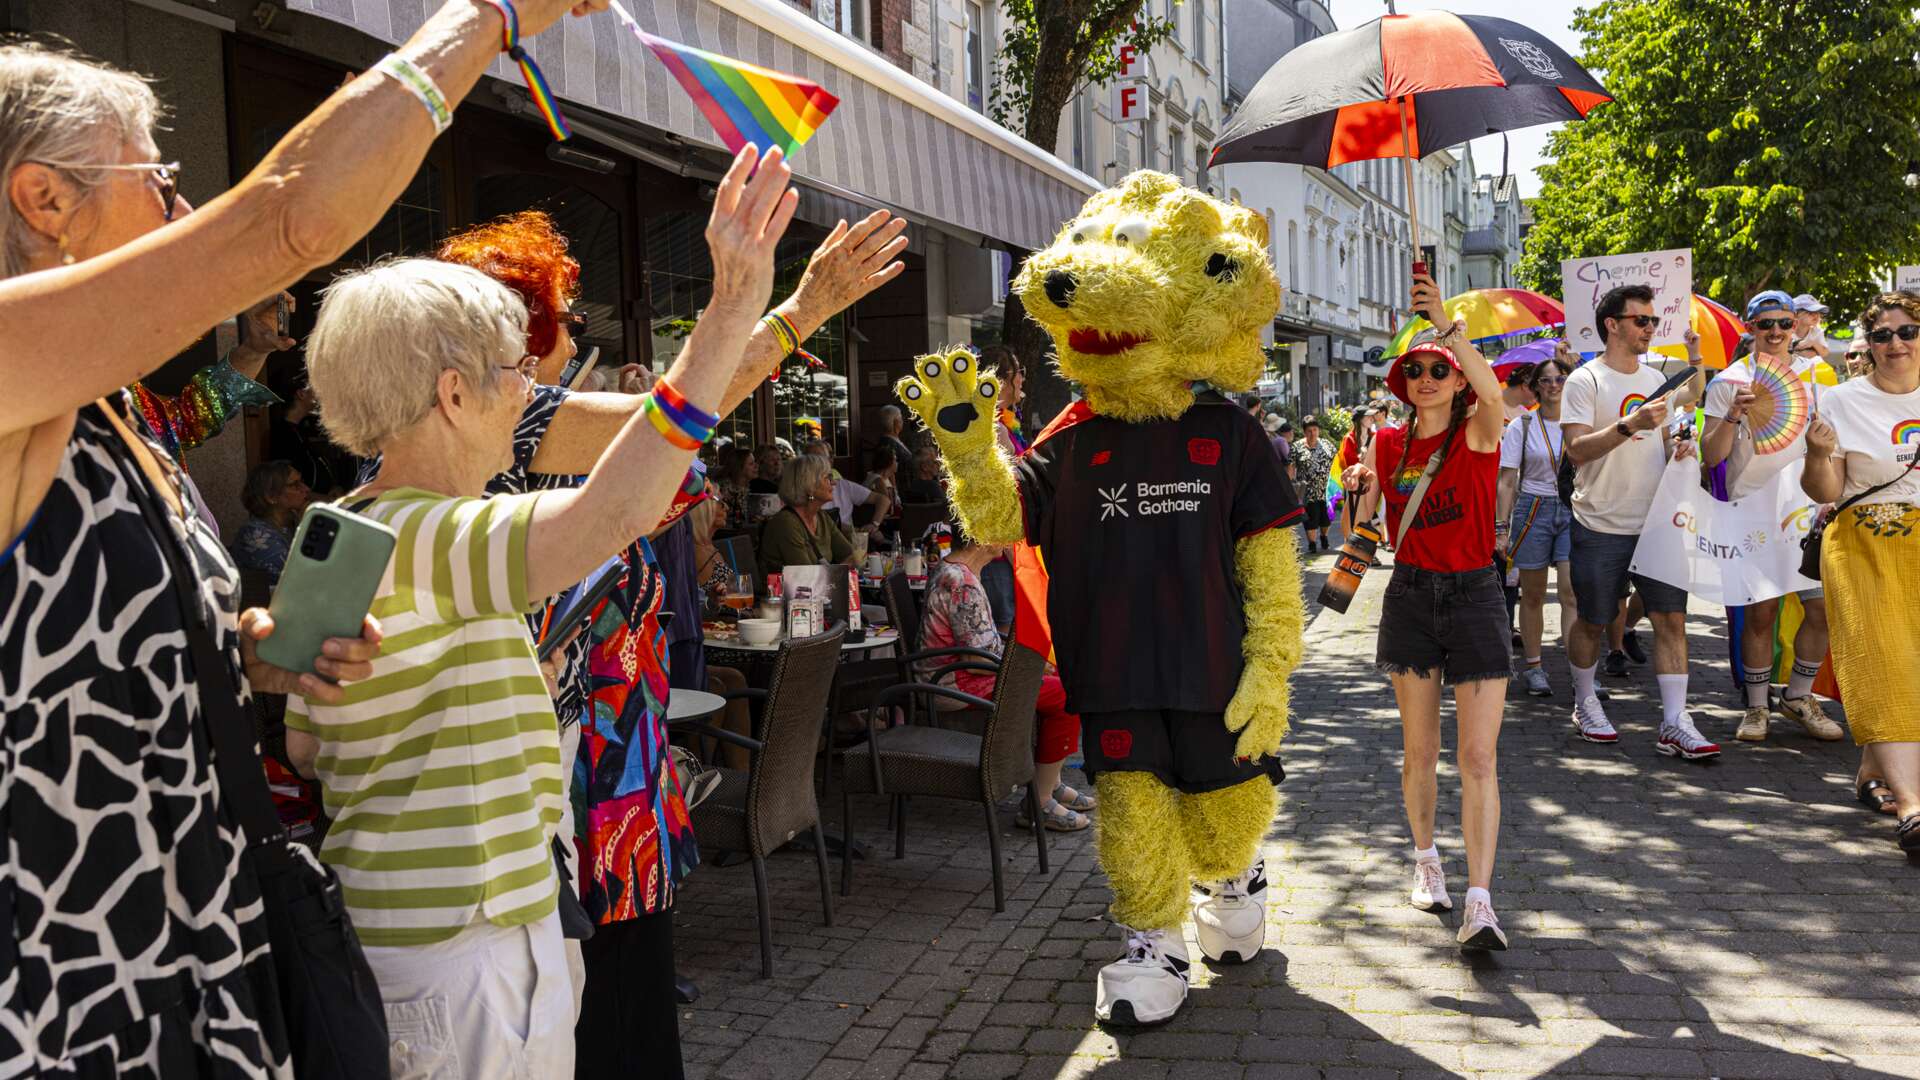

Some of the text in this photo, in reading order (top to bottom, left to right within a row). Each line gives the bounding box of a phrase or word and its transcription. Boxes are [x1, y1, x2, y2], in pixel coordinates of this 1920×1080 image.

[1577, 257, 1662, 283] Chemie
[1137, 479, 1211, 497] Barmenia
[1137, 499, 1201, 516] Gothaer
